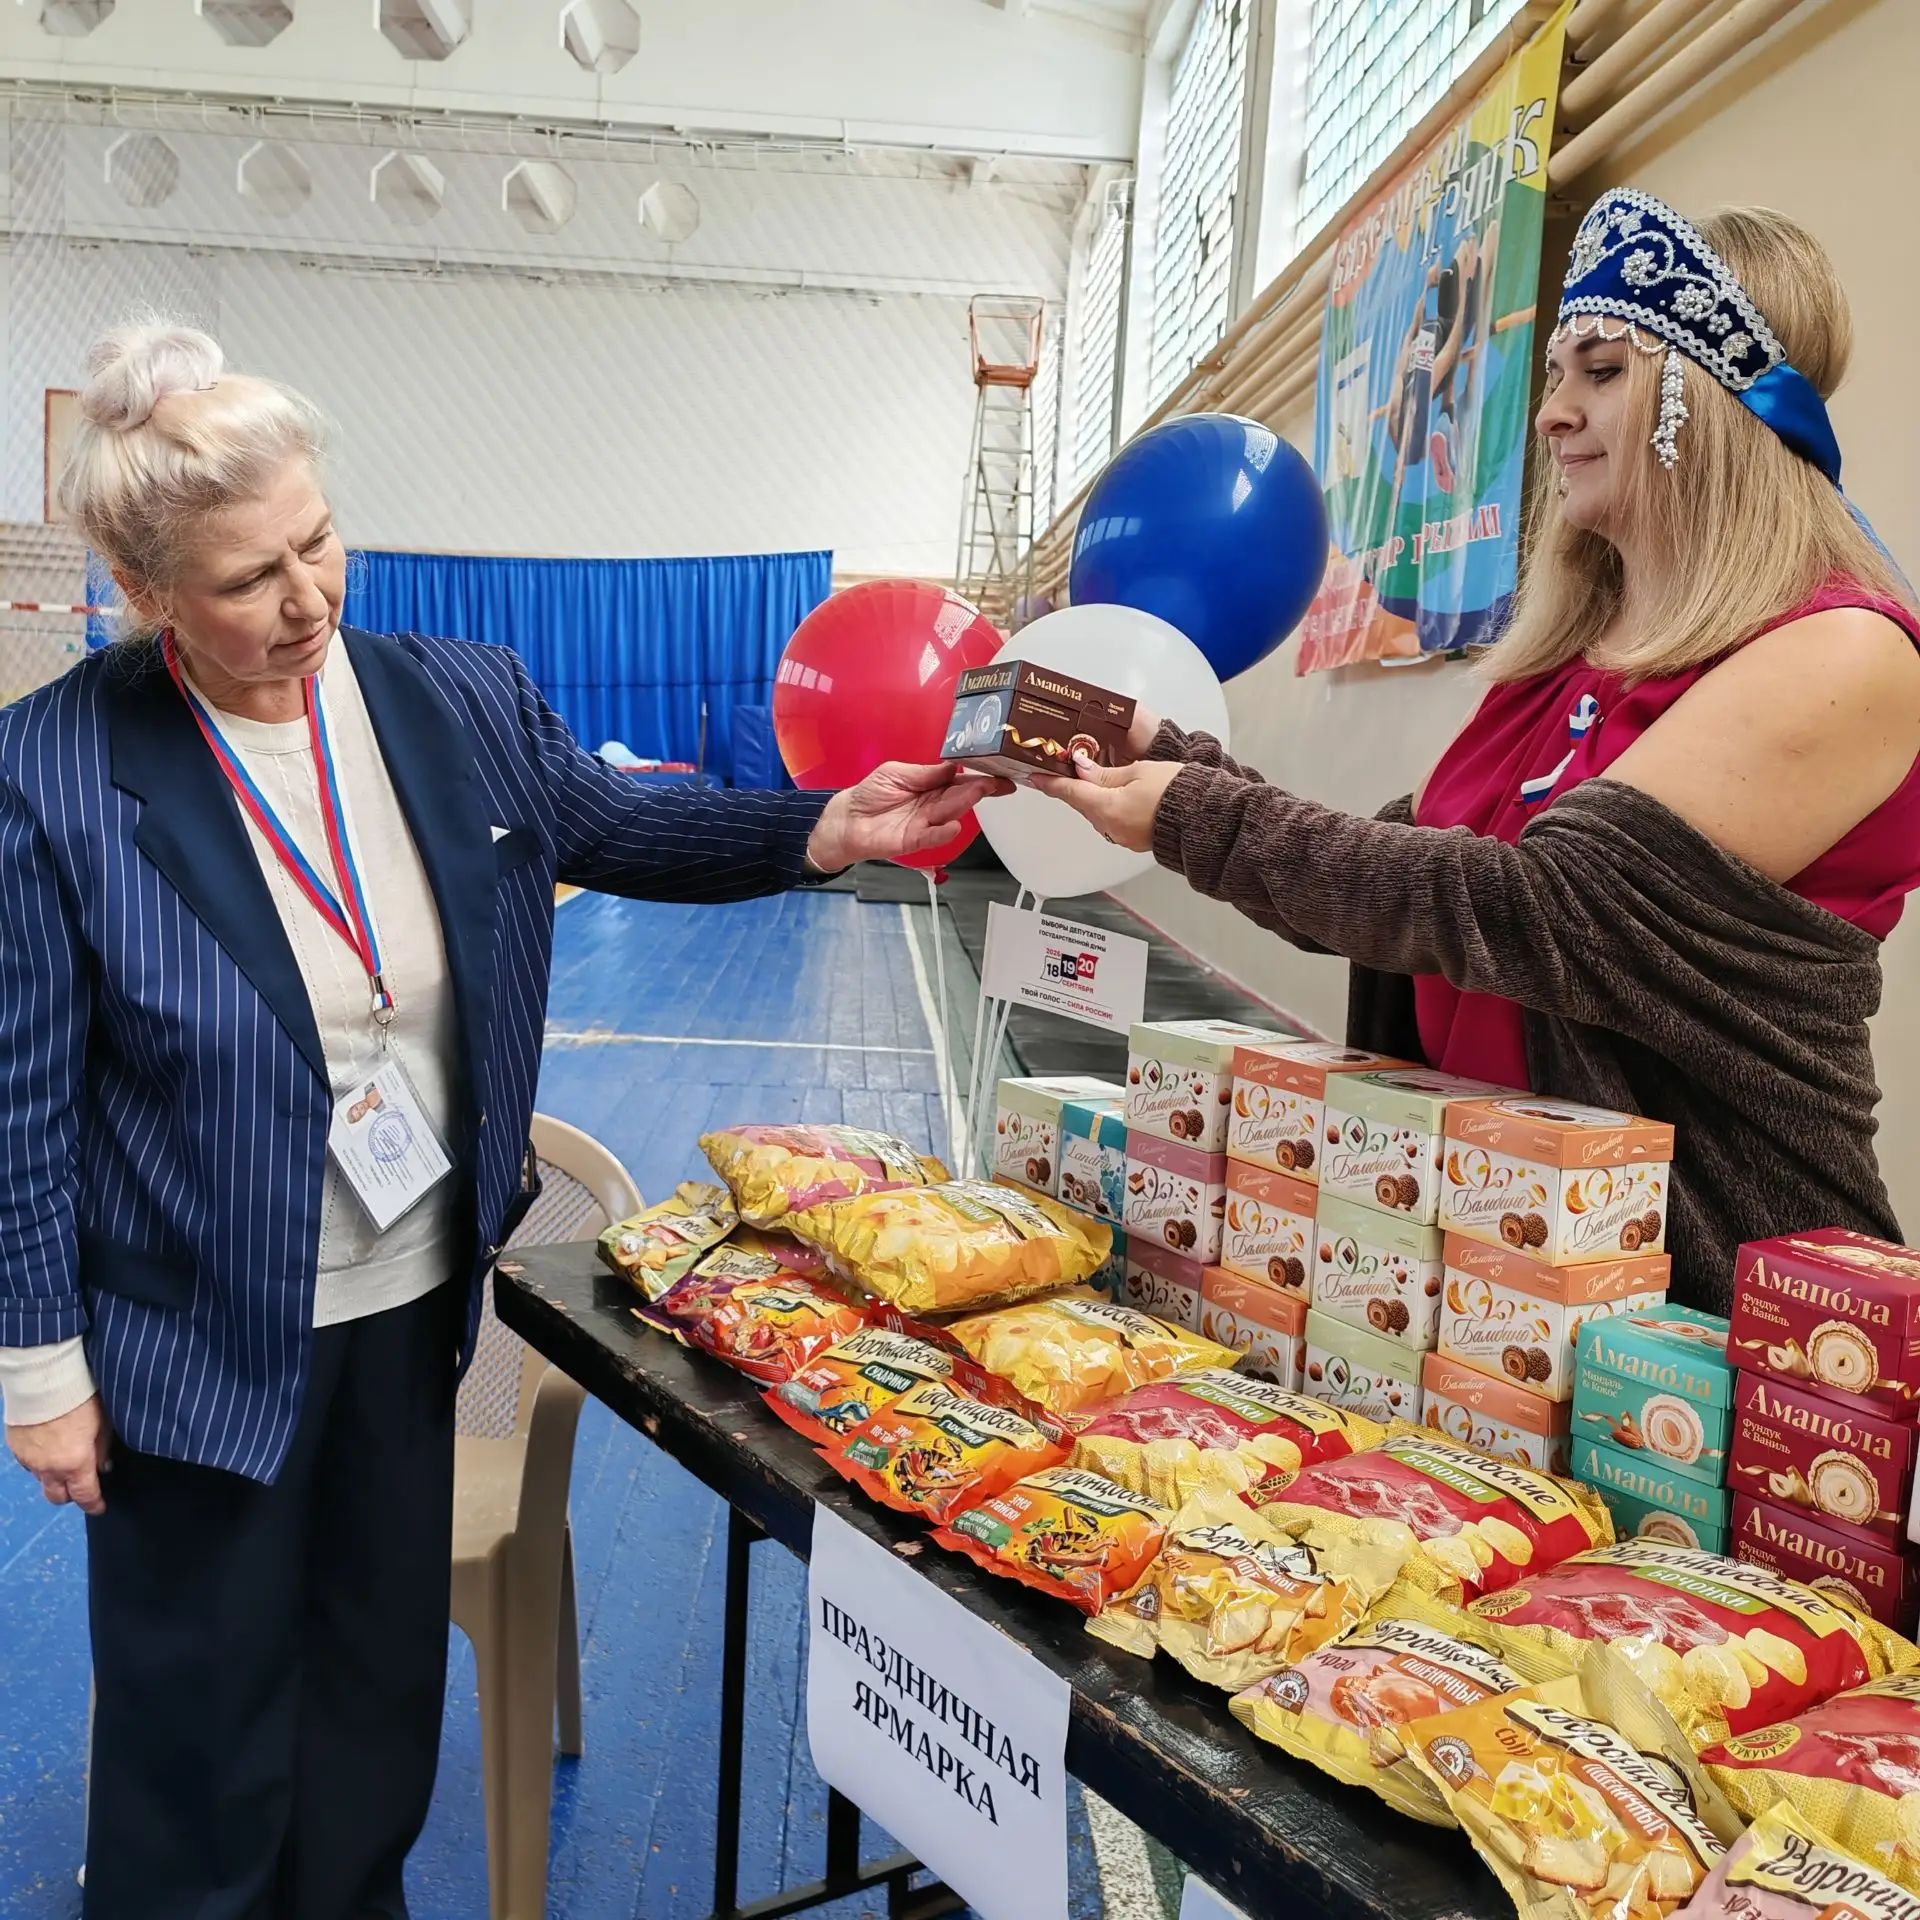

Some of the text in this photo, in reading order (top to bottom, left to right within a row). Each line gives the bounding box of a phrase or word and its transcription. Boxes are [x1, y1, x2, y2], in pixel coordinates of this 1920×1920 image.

[1038, 929, 1107, 953] ГОСУДАРСТВЕННОЙ ДУМЫ
[1041, 919, 1106, 942] ВЫБОРЫ ДЕПУТАТОВ
[1046, 958, 1095, 977] 18 19 20
[1021, 987, 1038, 998] ТВОЙ
[1039, 992, 1061, 1004] ГОЛОС
[1067, 1000, 1084, 1012] СИЛА
[1062, 979, 1094, 994] СЕНТЯБРЯ
[1134, 1091, 1191, 1116] Бамбино
[1239, 1119, 1298, 1147] Бамбино
[1067, 1144, 1113, 1170] Landrin
[1332, 1152, 1400, 1183] Бамбино
[1453, 1187, 1527, 1220] Бамбино
[1573, 1197, 1645, 1248] Бамбино
[1324, 1272, 1390, 1303] Бамбино
[1741, 1303, 1790, 1327] & Ваниль
[1742, 1293, 1781, 1313] Фундук
[1453, 1317, 1529, 1350] Бамбино
[864, 1365, 912, 1391] СУХАРИКИ
[1582, 1369, 1624, 1390] Миндаль
[1582, 1379, 1618, 1398] & Кокос
[1742, 1417, 1782, 1440] Фундук
[1742, 1428, 1791, 1454] & Ваниль
[1401, 1454, 1488, 1496] БОЧОНКИ
[1738, 1540, 1777, 1564] Фундук
[1739, 1550, 1748, 1561] &
[1647, 1568, 1750, 1607] БОЧОНКИ
[1399, 1658, 1485, 1705] ПШЕНИЧНЫЕ
[821, 1596, 1042, 1800] ПРАЗДНИЧНАЯ
[852, 1680, 999, 1827] ЯРМАРКА
[1582, 1761, 1669, 1840] ПШЕНИЧНЫЕ
